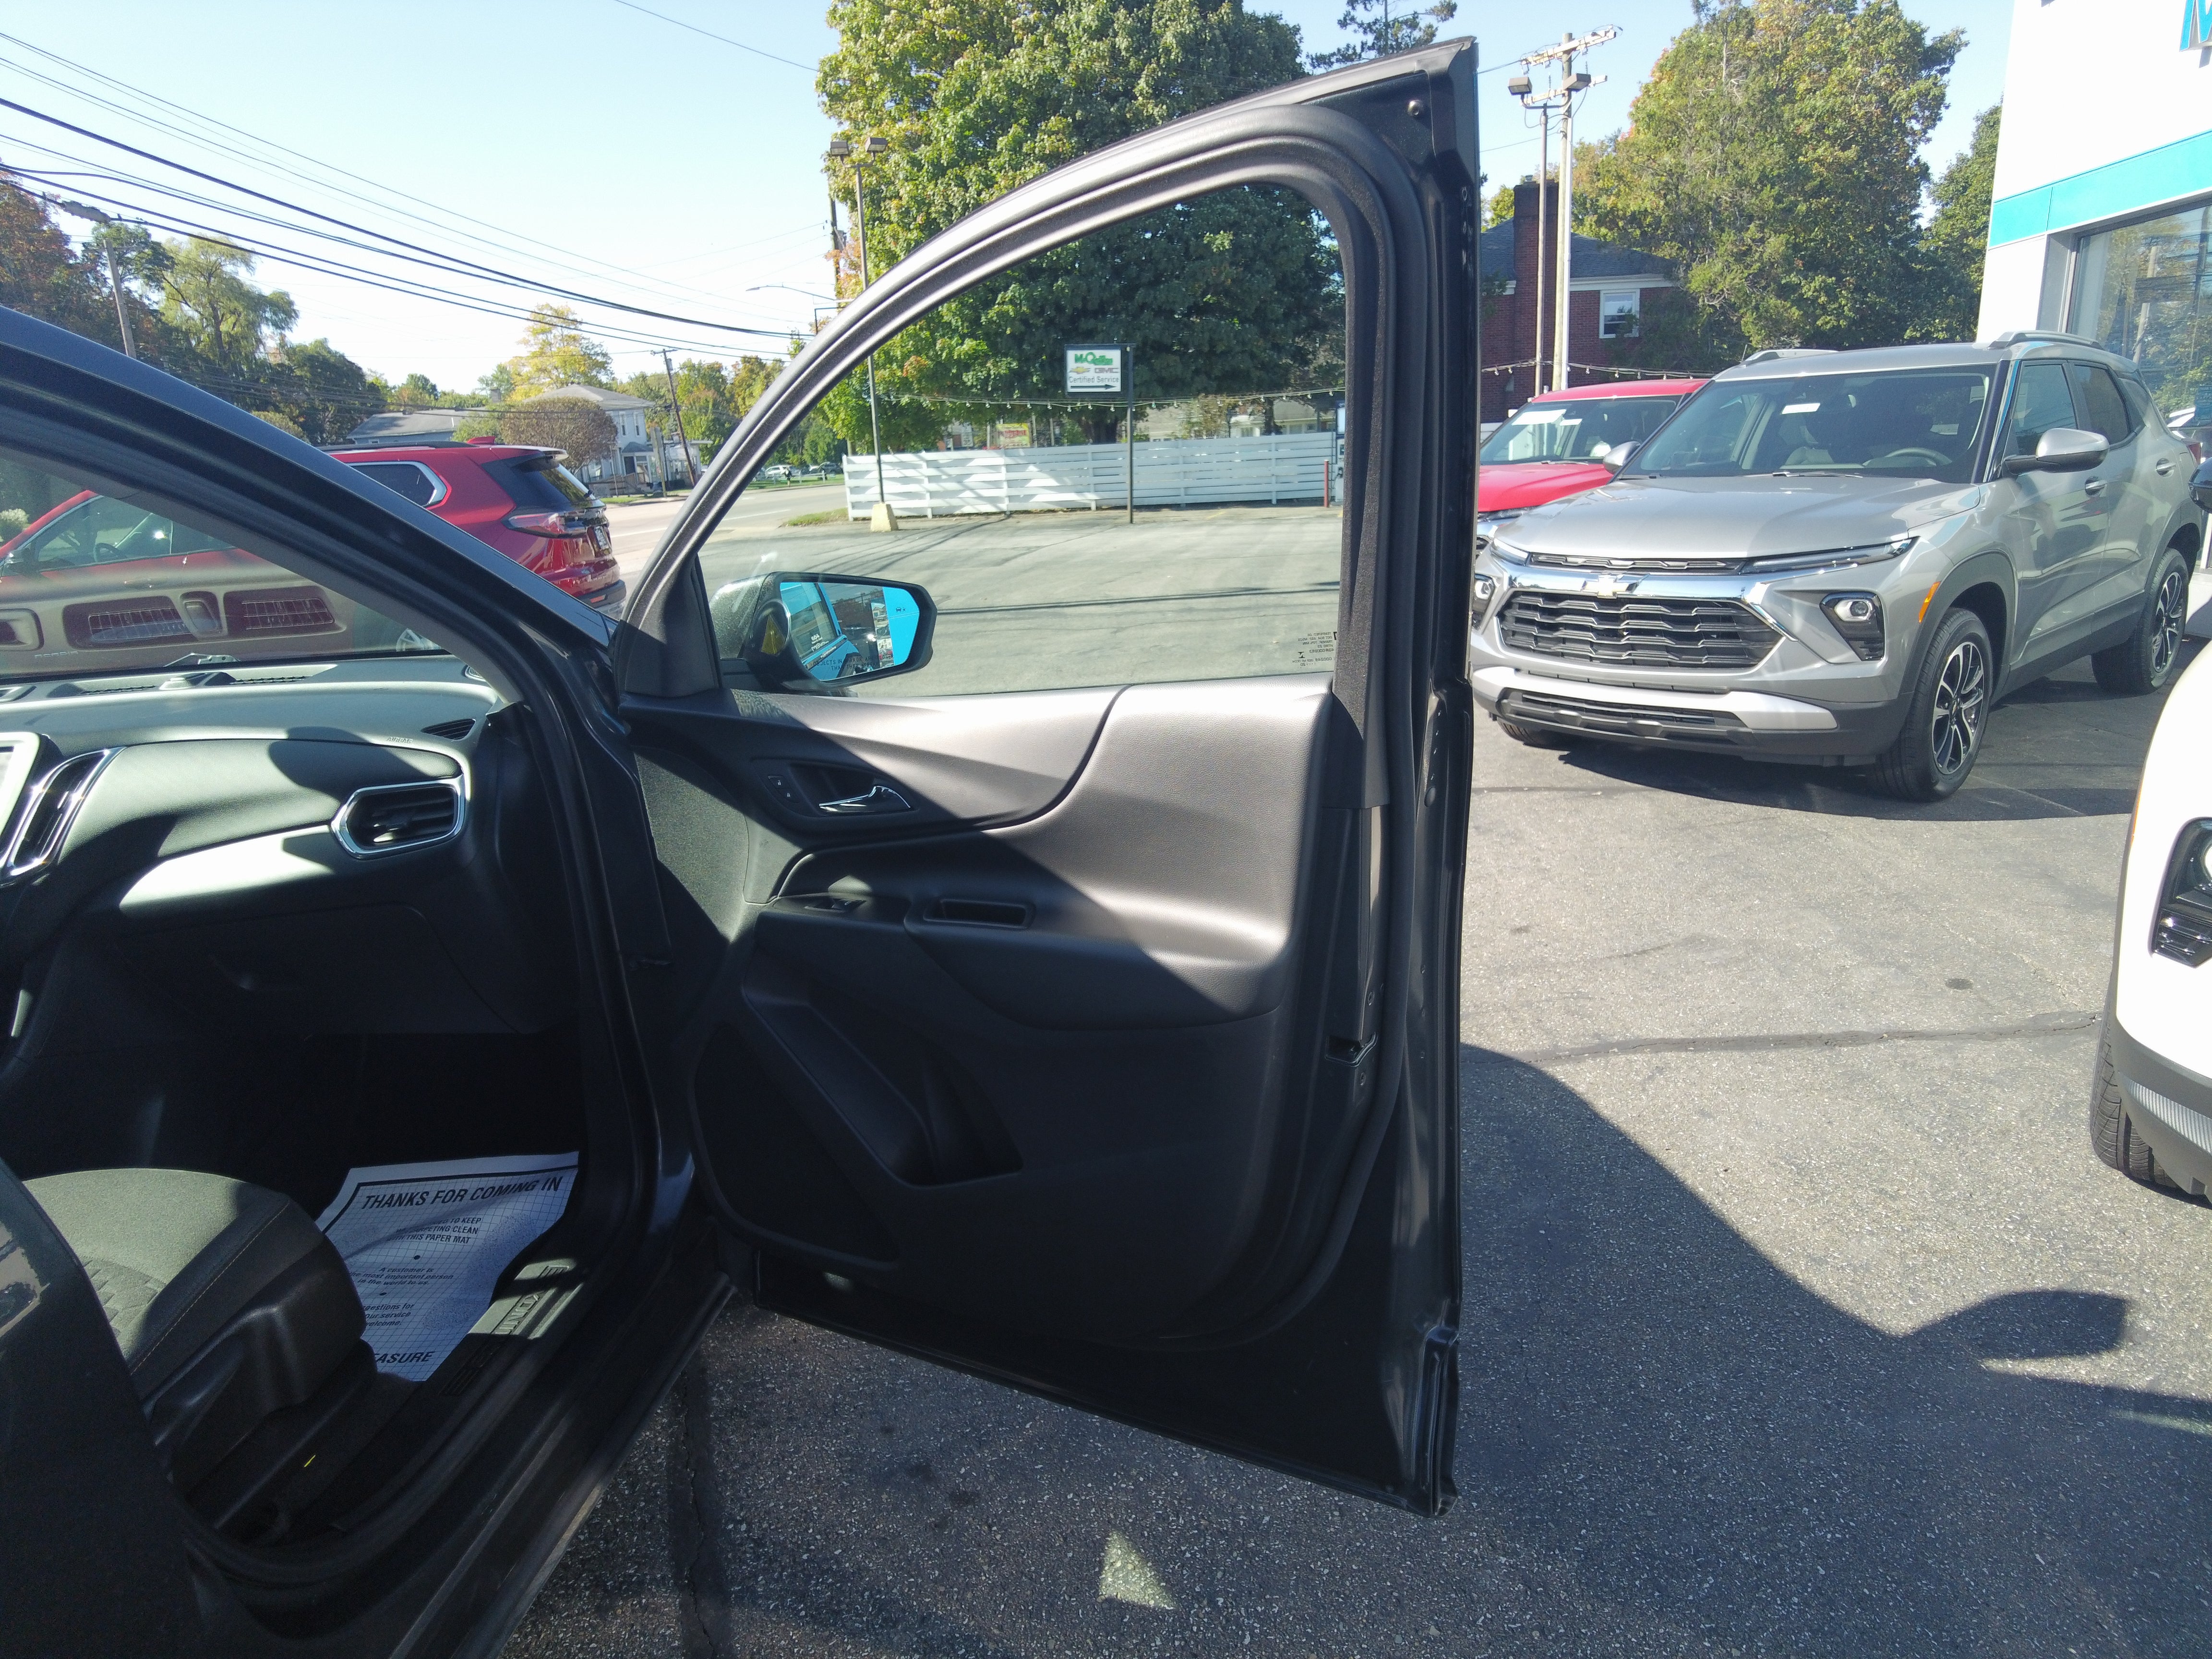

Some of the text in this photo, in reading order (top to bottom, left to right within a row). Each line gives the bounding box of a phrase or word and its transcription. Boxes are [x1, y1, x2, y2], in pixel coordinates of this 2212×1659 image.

[361, 1176, 564, 1210] THANKS FOR COMING IN
[453, 1226, 479, 1234] CLEAN
[426, 1234, 452, 1242] PAPER
[453, 1236, 471, 1244] MAT
